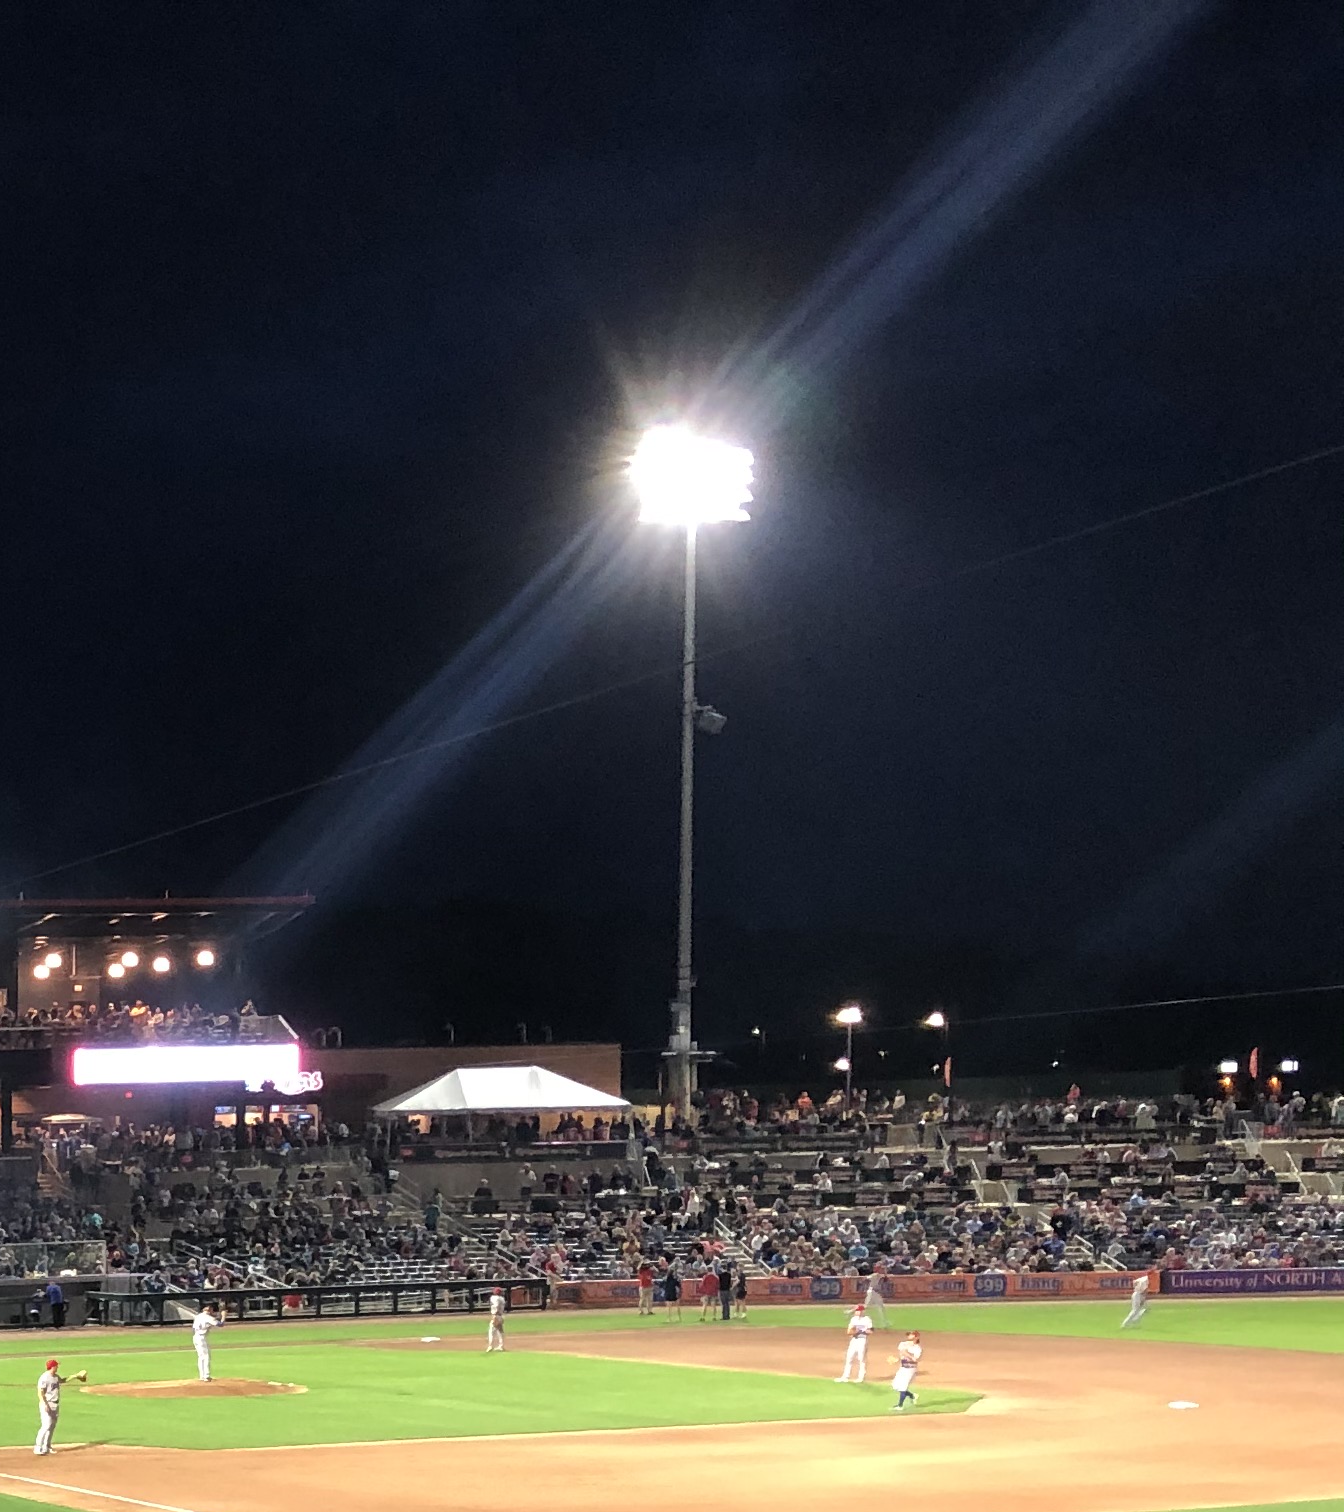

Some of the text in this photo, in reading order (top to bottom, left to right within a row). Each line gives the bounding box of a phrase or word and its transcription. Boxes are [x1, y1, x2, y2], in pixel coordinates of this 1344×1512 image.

[977, 1275, 1005, 1292] $99
[1172, 1271, 1344, 1288] University of NORTH A
